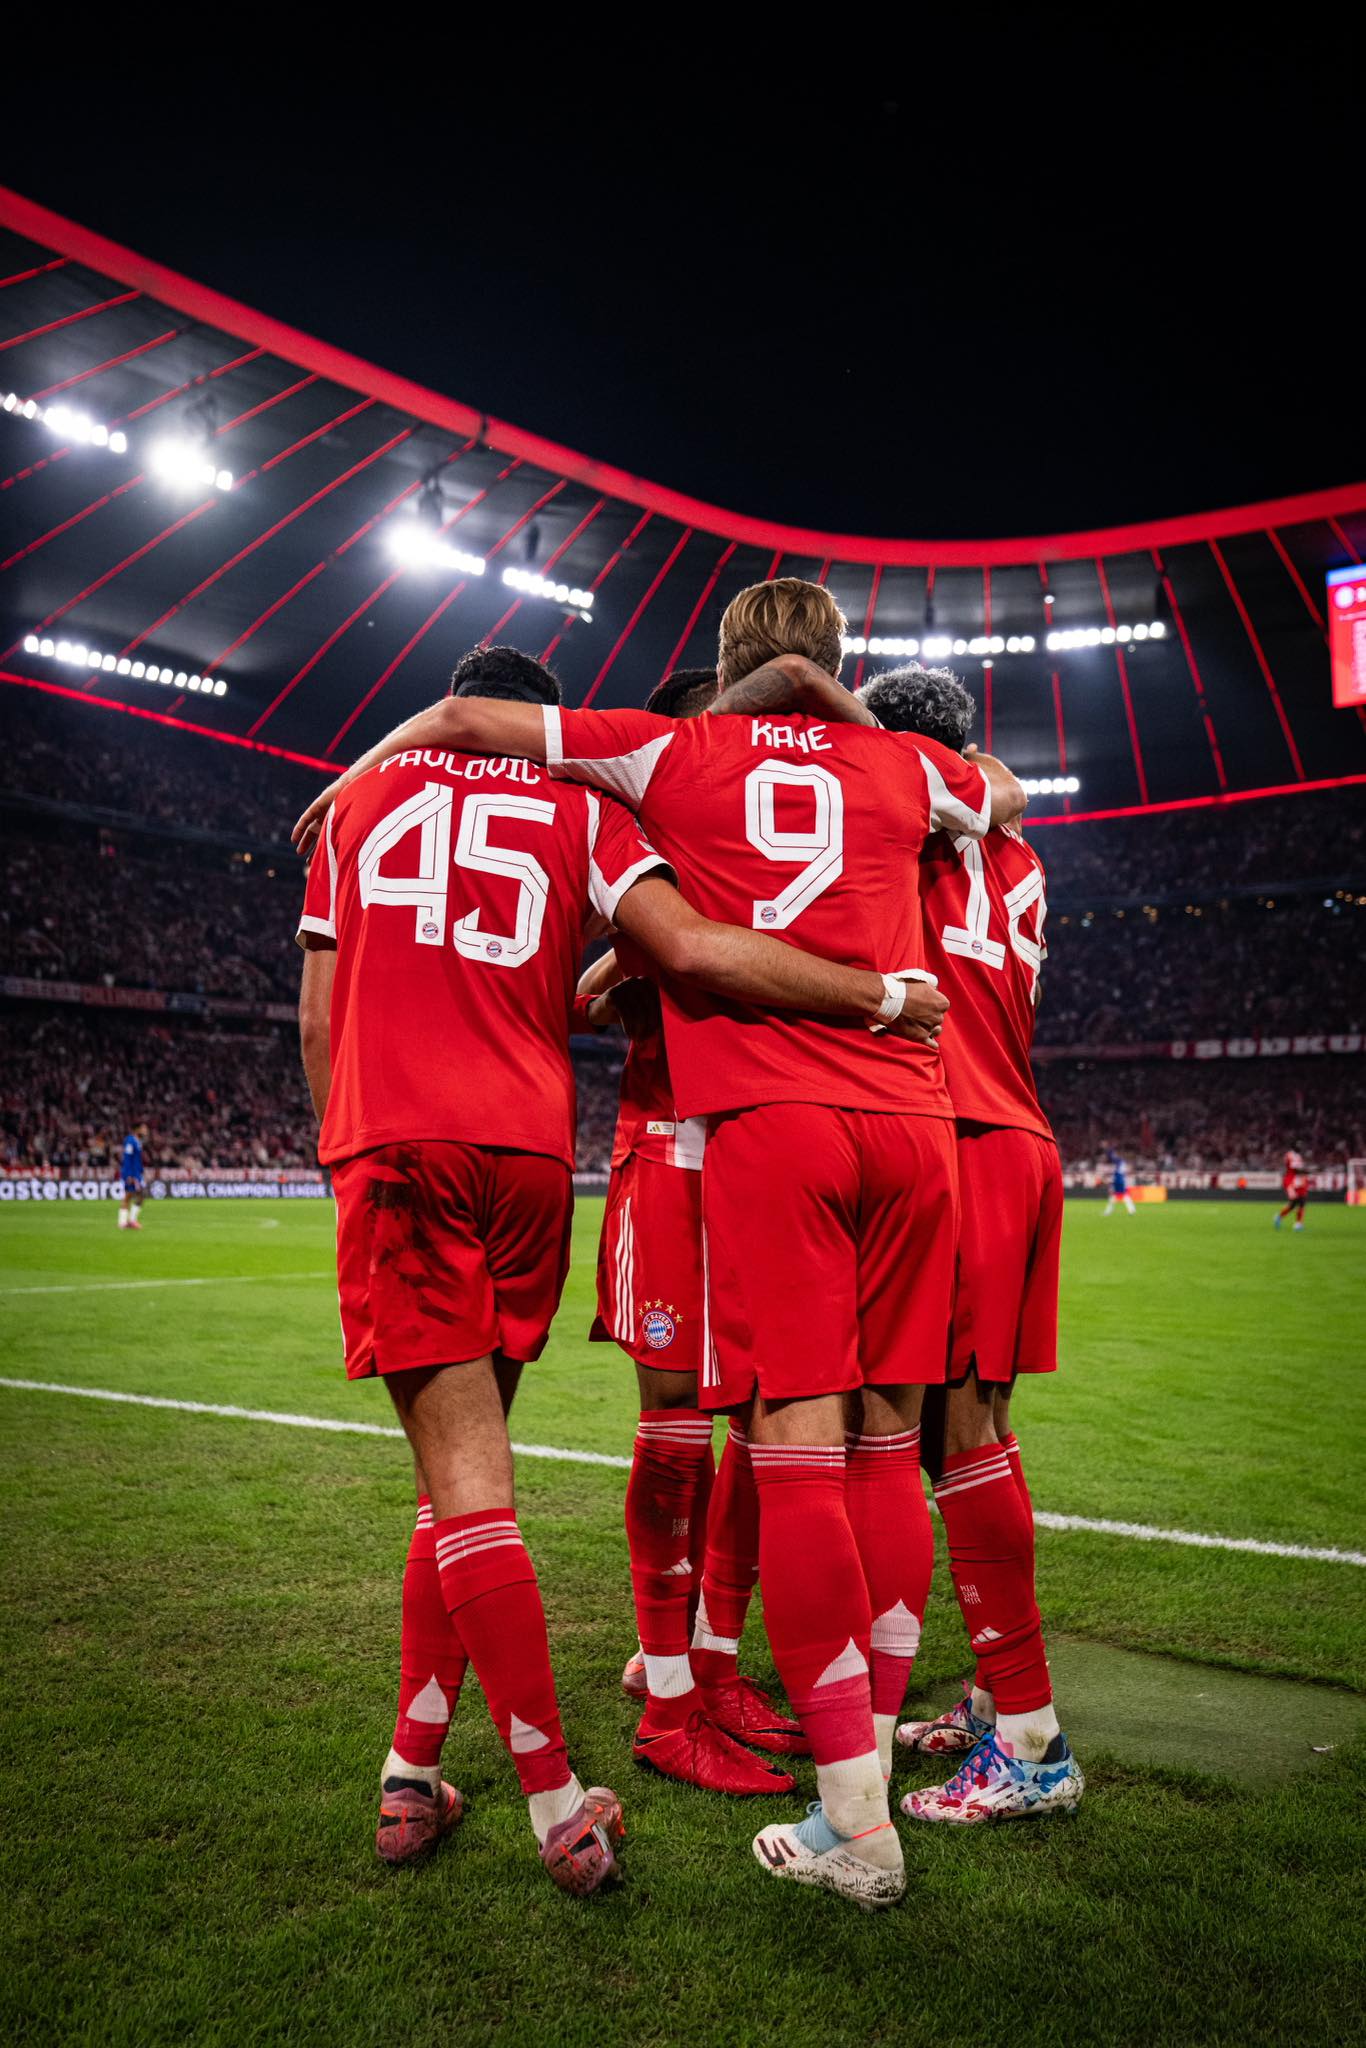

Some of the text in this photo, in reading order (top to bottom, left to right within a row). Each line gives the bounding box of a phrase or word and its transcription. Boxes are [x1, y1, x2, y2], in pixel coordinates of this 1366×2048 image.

[358, 781, 557, 969] 45
[745, 758, 844, 930] 9
[170, 1182, 327, 1199] UEFA CHAMPIONS LEAGUE
